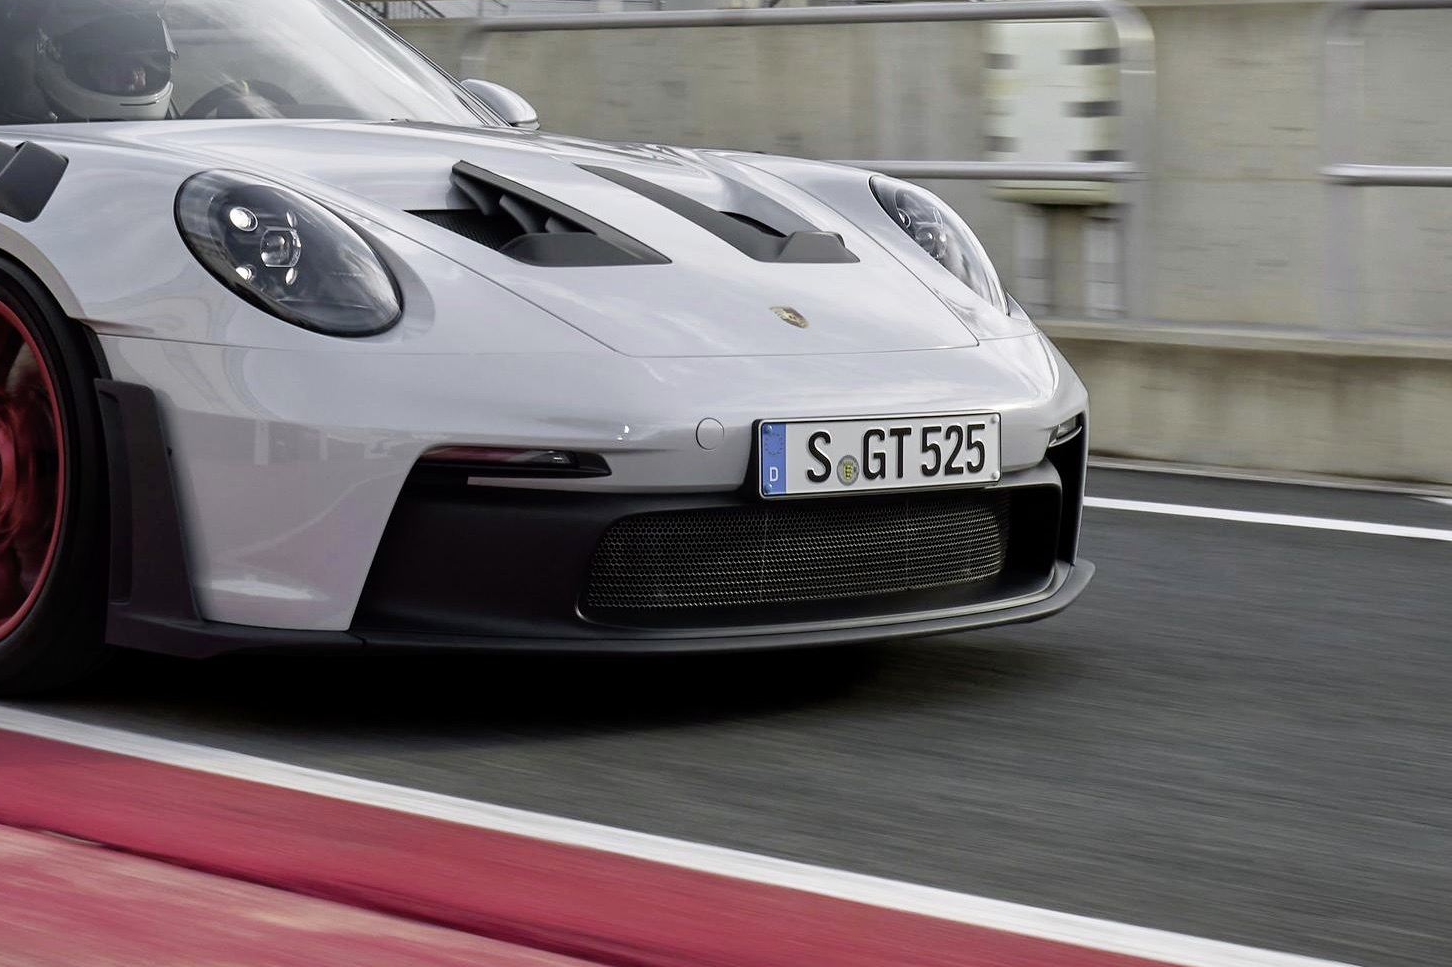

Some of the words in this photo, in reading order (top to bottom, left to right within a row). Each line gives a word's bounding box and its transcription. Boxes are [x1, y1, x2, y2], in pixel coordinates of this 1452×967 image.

[807, 431, 832, 483] S
[863, 427, 912, 480] GT
[921, 423, 986, 477] 525
[769, 466, 779, 482] D
